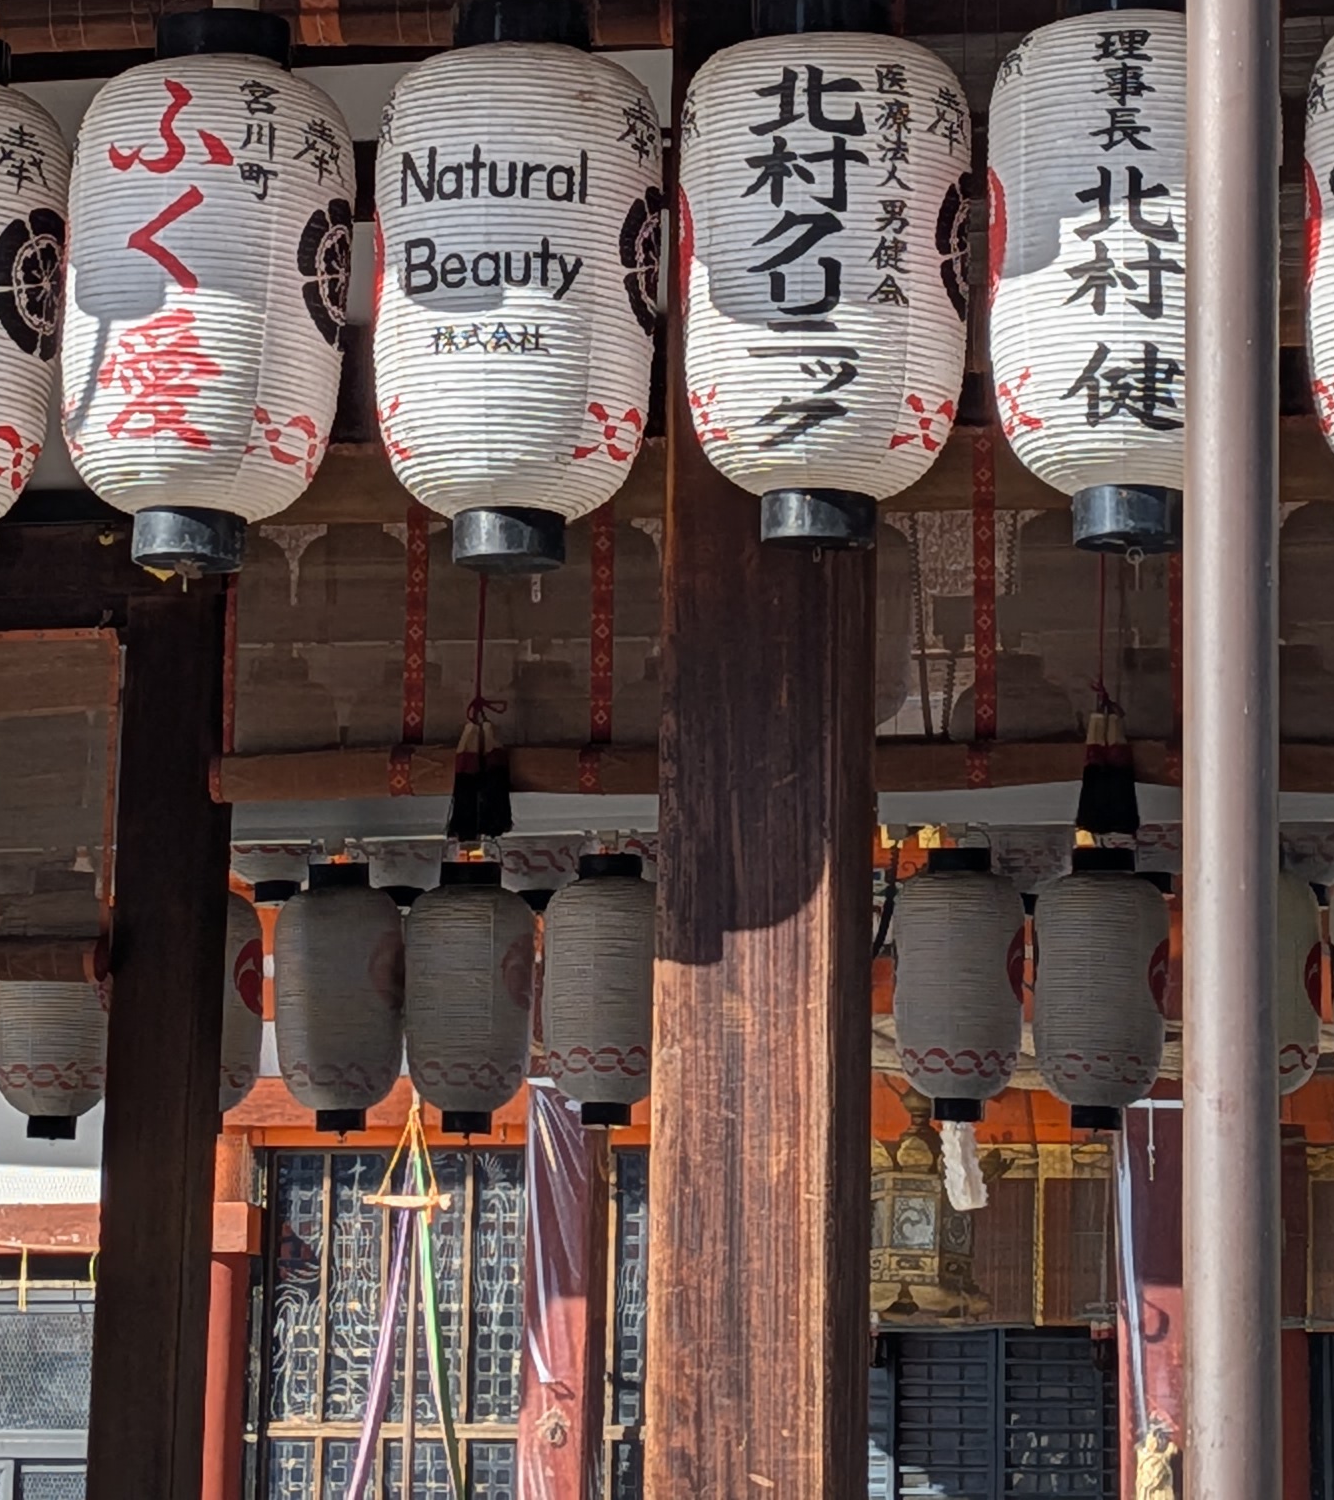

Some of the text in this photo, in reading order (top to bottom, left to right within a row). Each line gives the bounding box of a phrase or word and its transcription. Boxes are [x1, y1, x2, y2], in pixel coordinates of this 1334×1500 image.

[236, 80, 280, 200] 宮川町
[1089, 29, 1157, 152] 理事長
[400, 143, 588, 207] Natural
[98, 78, 235, 450] ふく愛
[404, 236, 583, 300] Beauty
[740, 64, 871, 450] 北村クリニック
[427, 322, 551, 355] 株式会社
